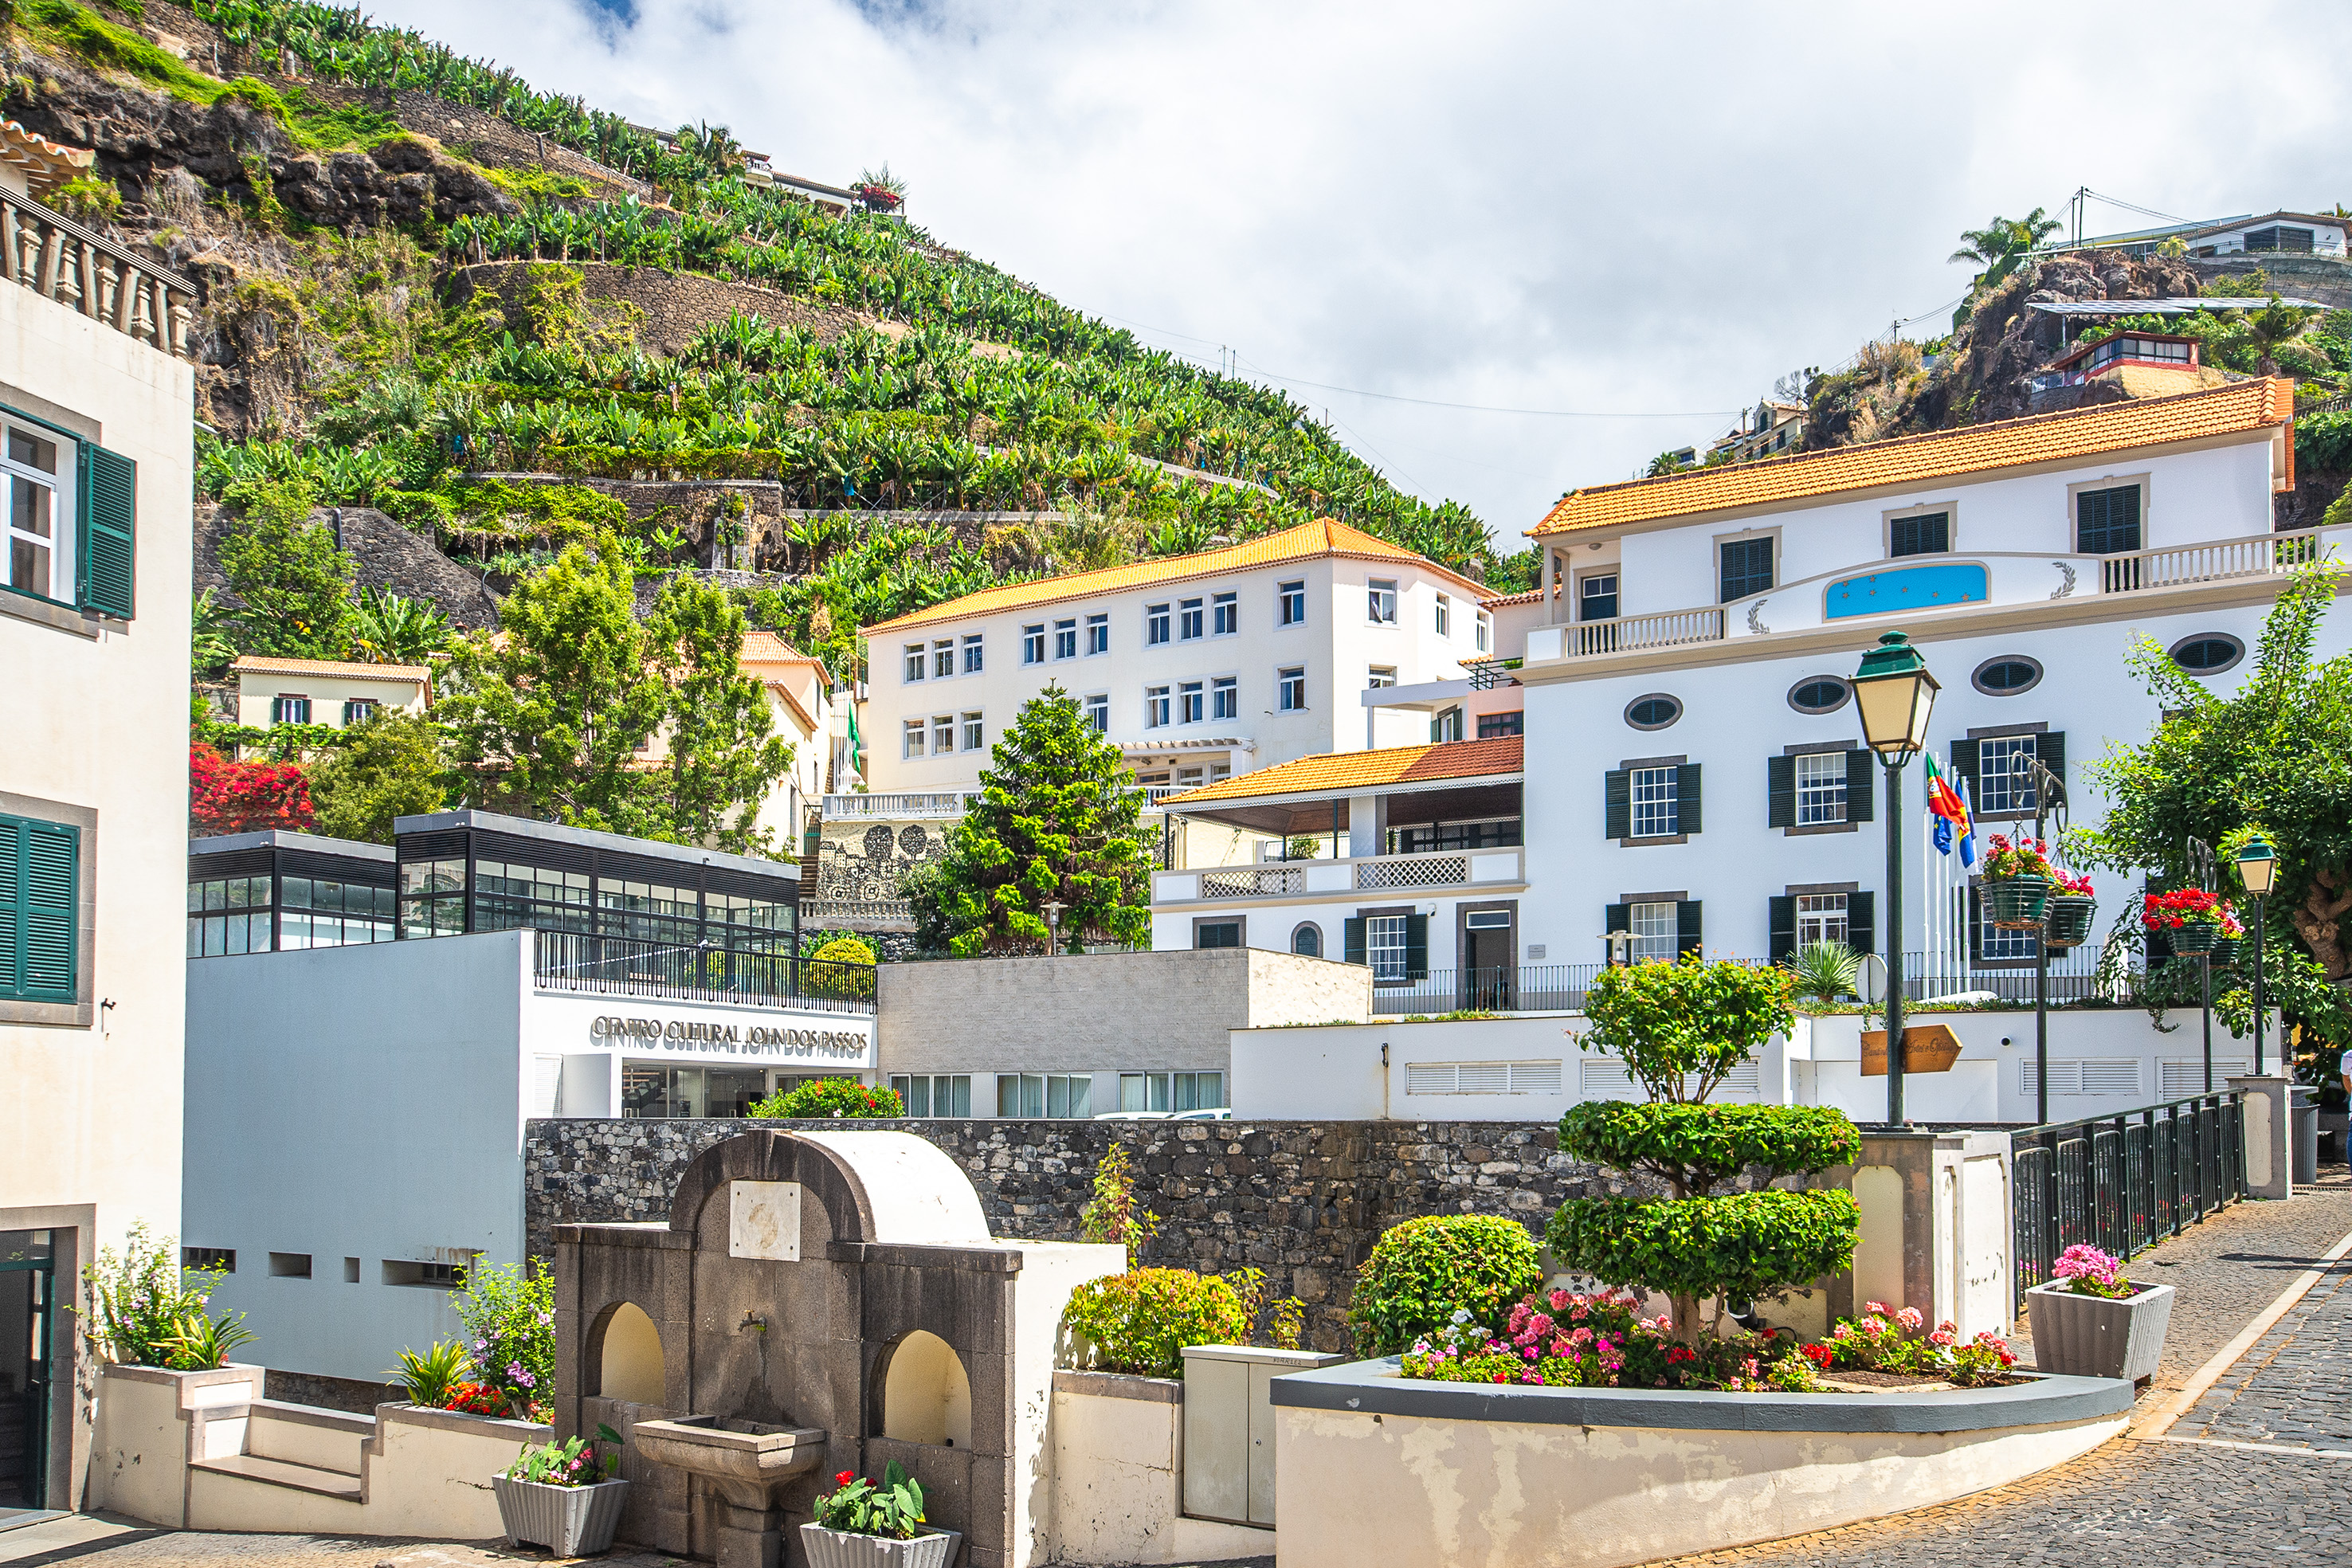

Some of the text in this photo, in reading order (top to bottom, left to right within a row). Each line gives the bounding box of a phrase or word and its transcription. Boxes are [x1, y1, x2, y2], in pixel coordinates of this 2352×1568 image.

[592, 1016, 868, 1049] CENTRO CULTURAL JOHN DOS PASSOS
